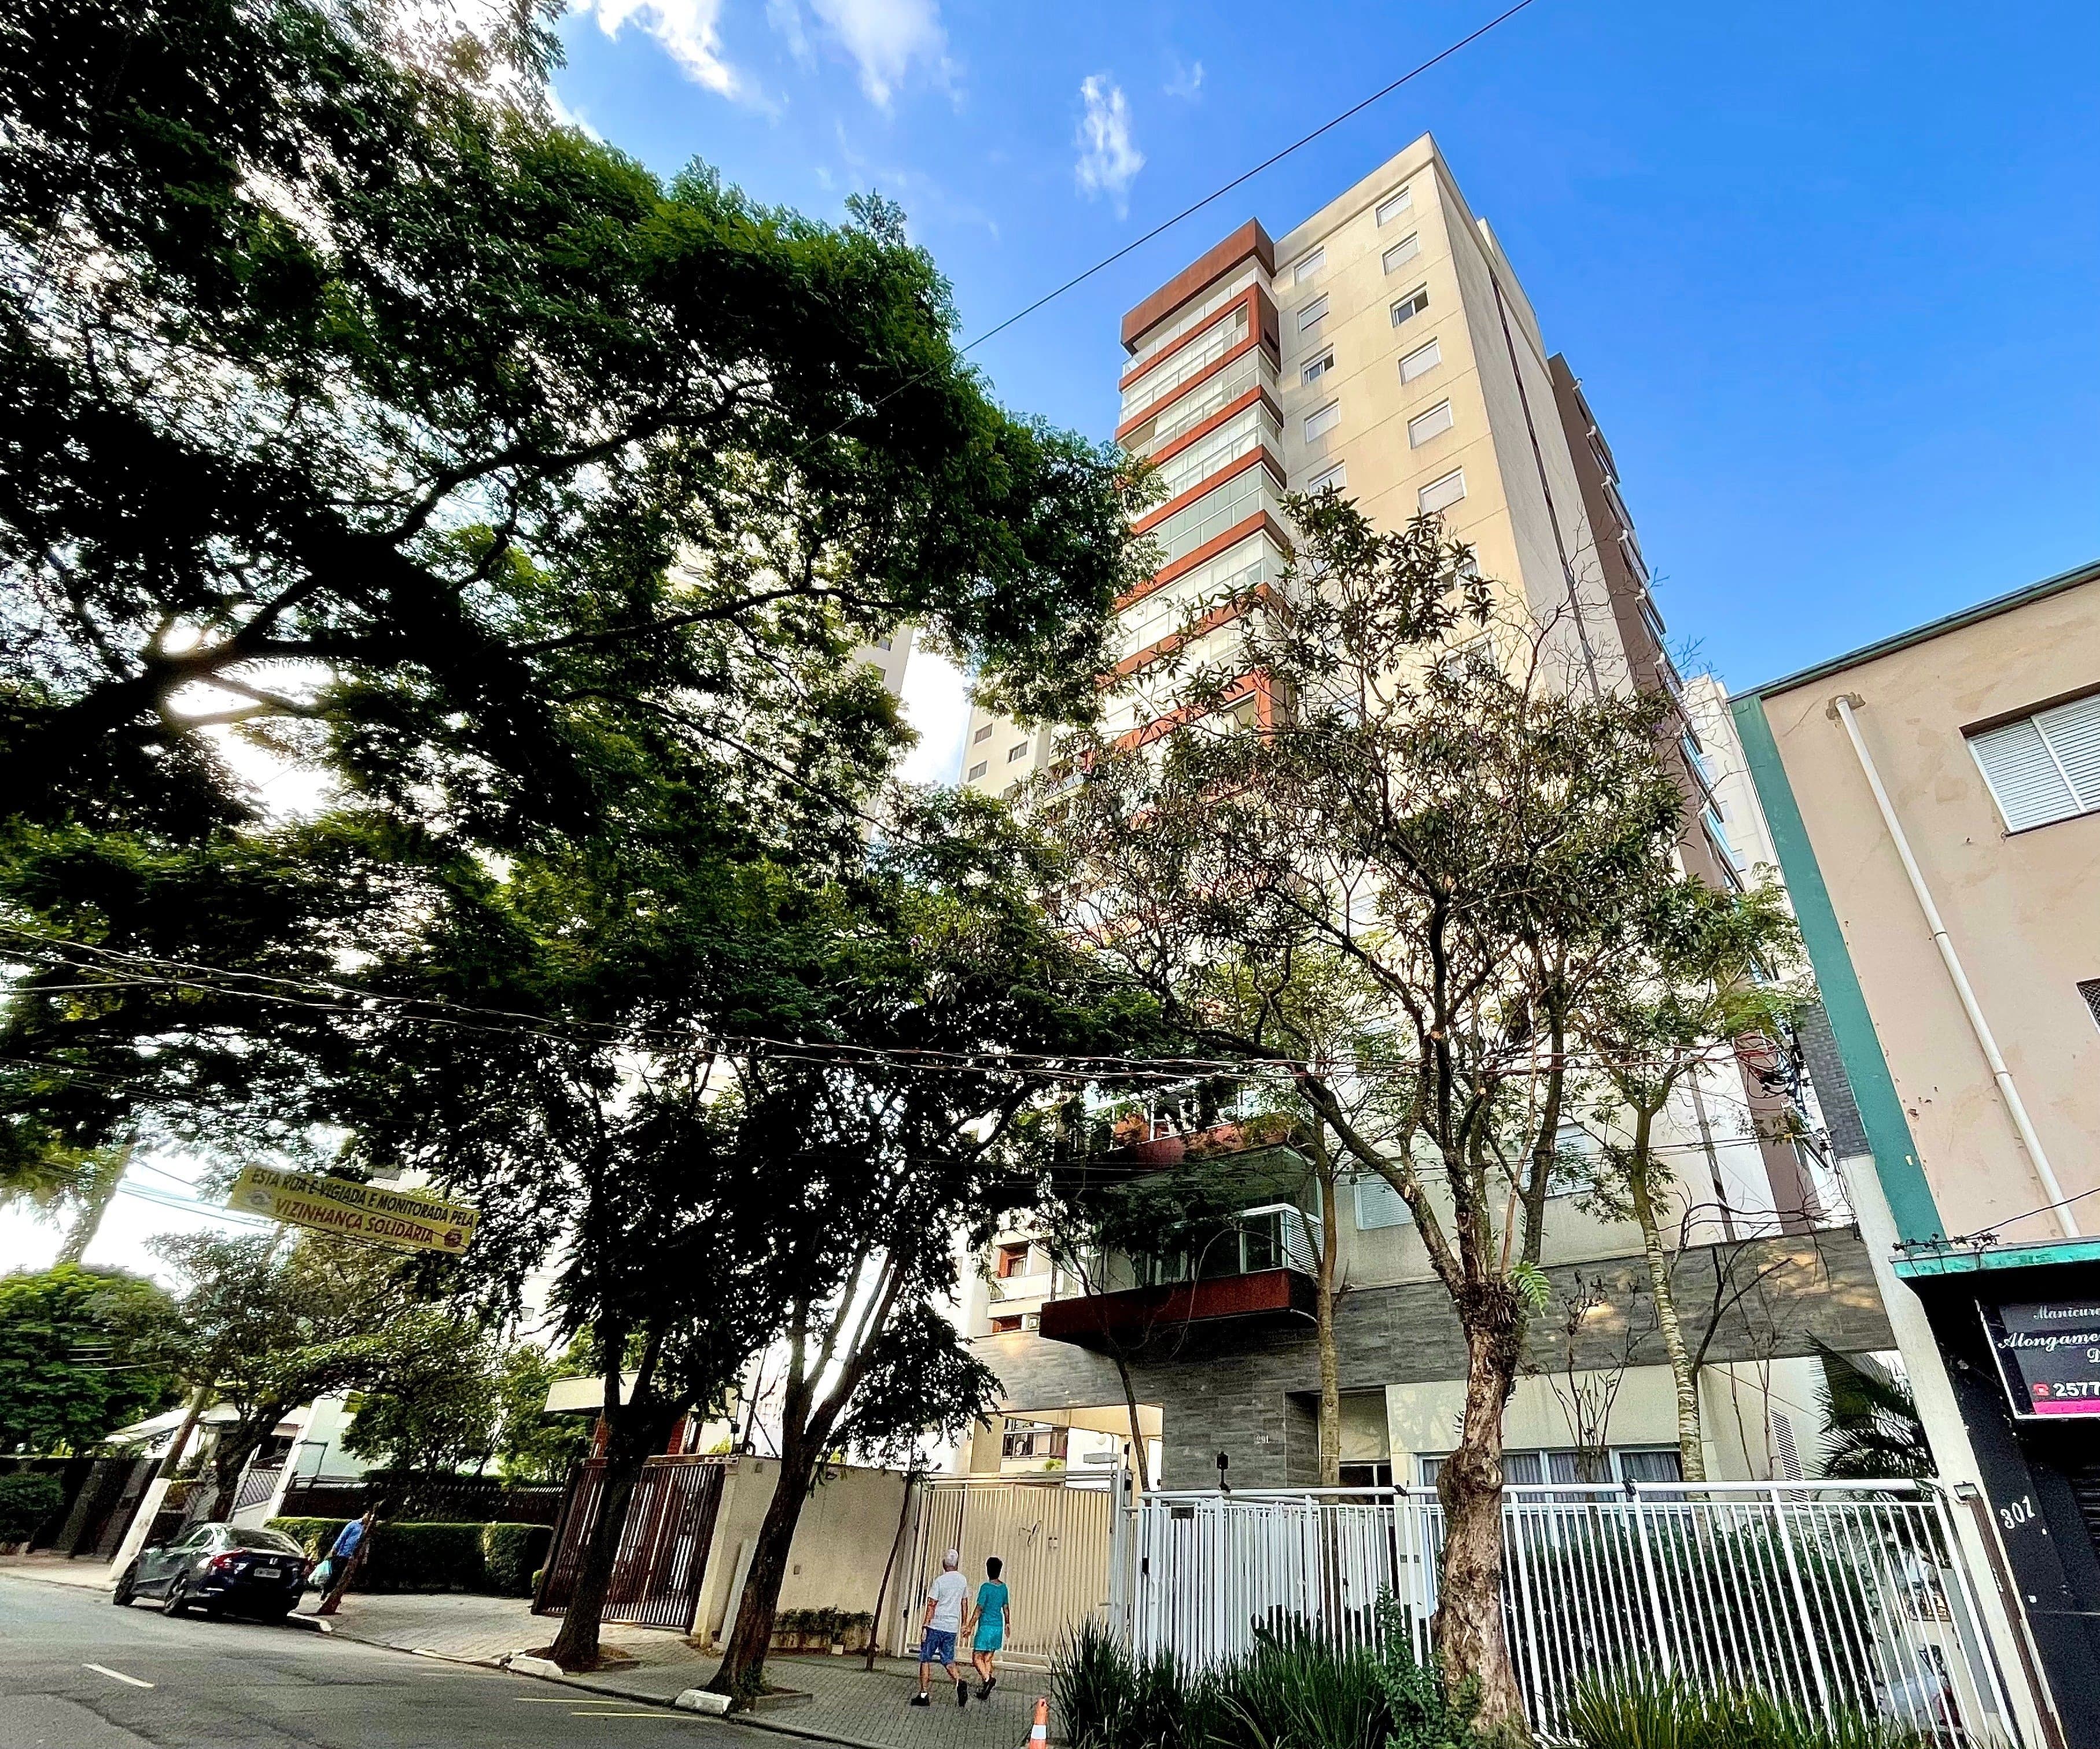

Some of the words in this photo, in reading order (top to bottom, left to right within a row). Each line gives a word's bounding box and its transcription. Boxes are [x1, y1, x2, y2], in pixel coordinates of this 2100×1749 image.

[250, 1168, 280, 1188] ESTA
[283, 1174, 307, 1193] RUA
[319, 1181, 366, 1205] VIGIADA
[367, 1192, 378, 1207] E
[376, 1194, 449, 1223] MONITORADA
[449, 1209, 474, 1228] PELA
[2053, 1381, 2100, 1397] 2577
